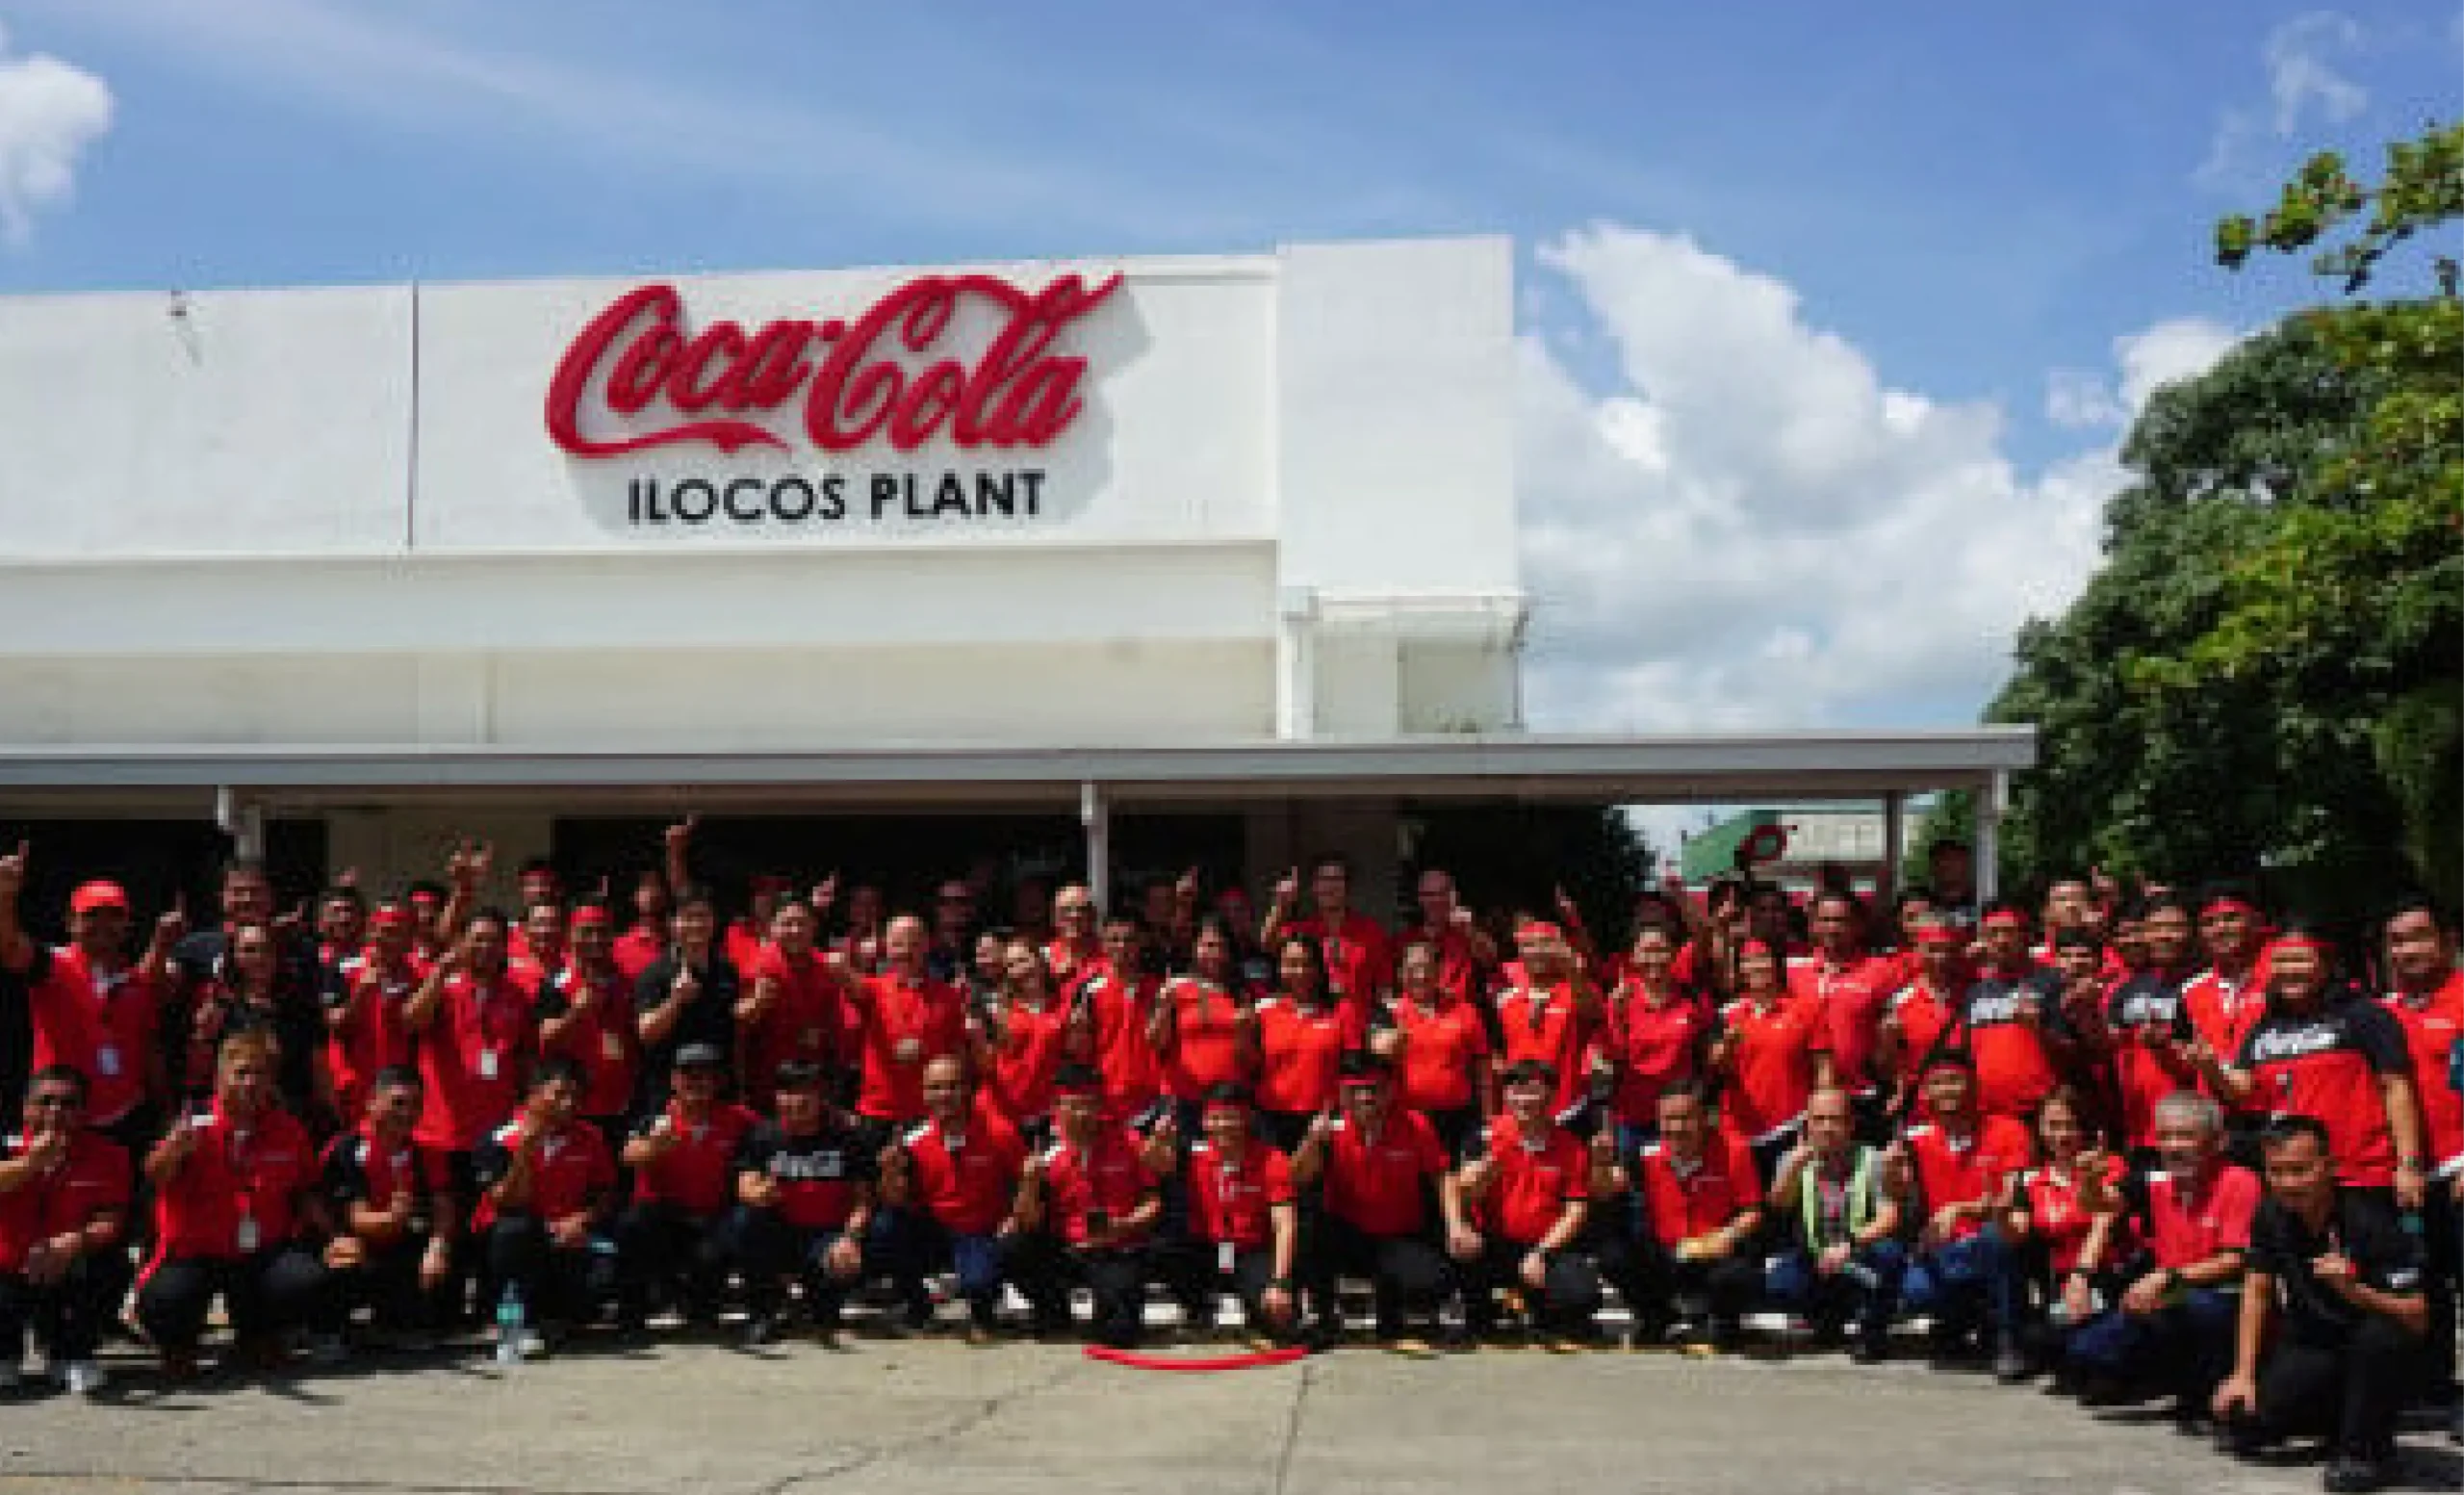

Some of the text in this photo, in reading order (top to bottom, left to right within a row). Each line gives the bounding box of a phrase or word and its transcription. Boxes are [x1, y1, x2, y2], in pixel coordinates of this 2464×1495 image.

[544, 271, 1124, 459] Coca-Cola
[628, 470, 1046, 525] ILOCOS PLANT
